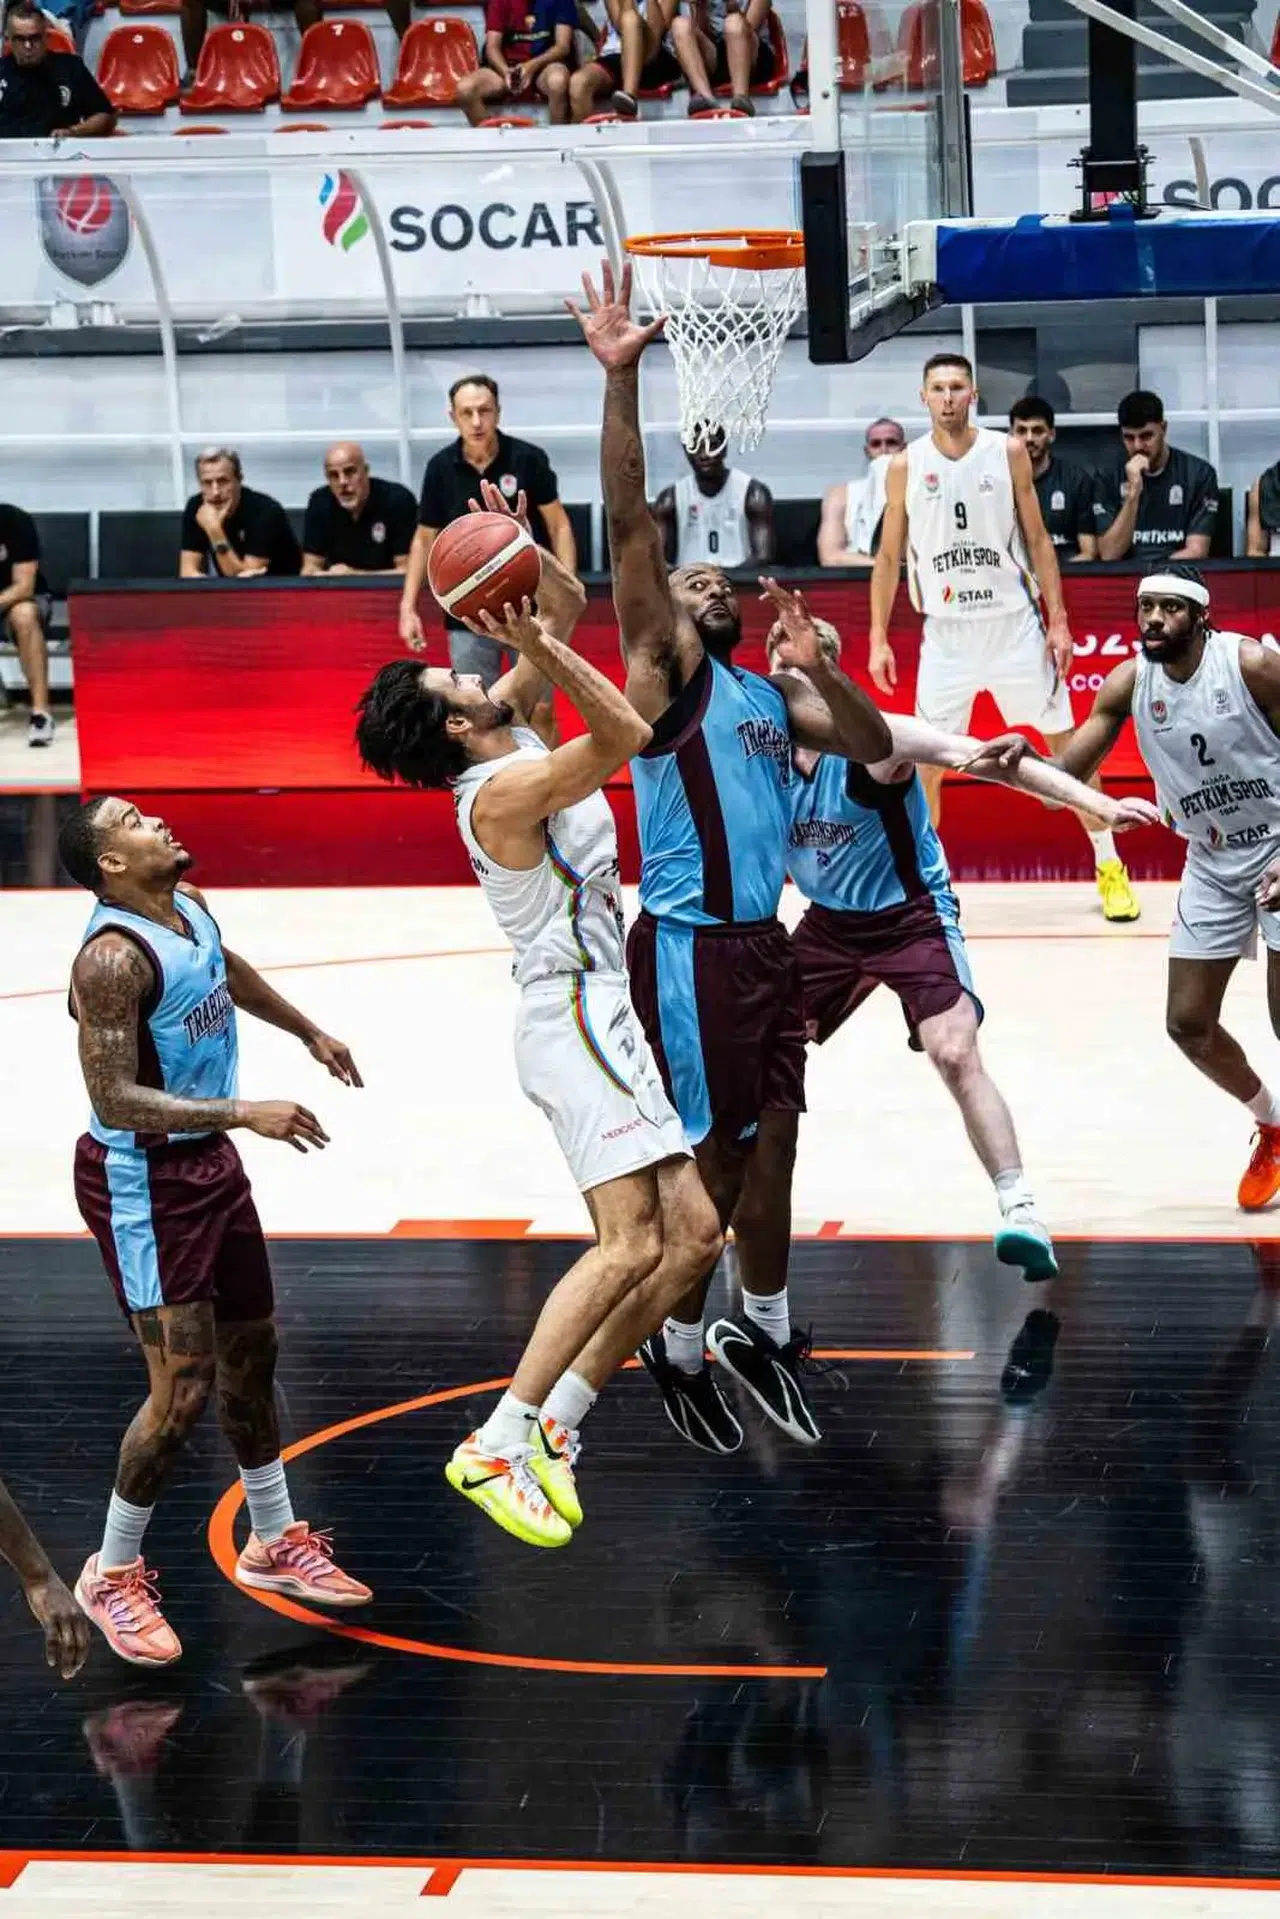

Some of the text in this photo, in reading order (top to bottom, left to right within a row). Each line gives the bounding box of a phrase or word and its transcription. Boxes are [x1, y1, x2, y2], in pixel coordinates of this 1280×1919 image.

[331, 23, 344, 36] 7
[390, 202, 605, 252] SOCAR
[954, 501, 968, 530] 9
[708, 530, 719, 554] 0
[958, 589, 993, 602] STAR
[1190, 733, 1216, 766] 2
[1226, 823, 1271, 843] STAR
